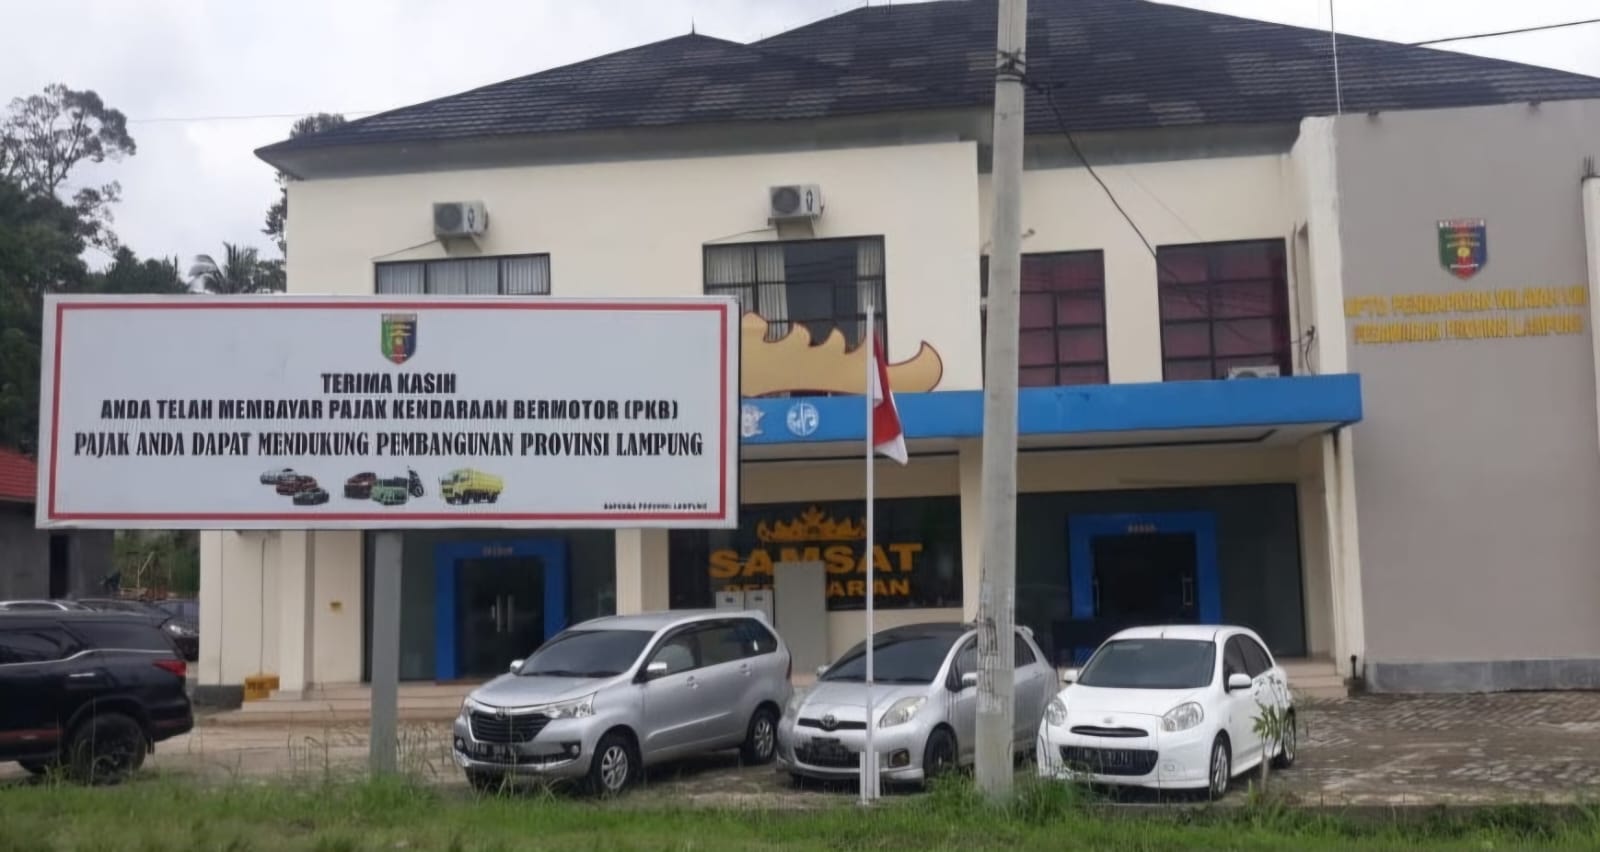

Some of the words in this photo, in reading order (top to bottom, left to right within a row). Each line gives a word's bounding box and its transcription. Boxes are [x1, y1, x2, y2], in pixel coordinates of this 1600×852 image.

[321, 373, 392, 394] TERIMA
[398, 373, 456, 394] KASIH
[101, 399, 151, 420] ANDA
[157, 399, 212, 420] TELAH
[219, 399, 323, 420] MEMBAYAR
[329, 399, 387, 420] PAJAK
[393, 399, 507, 420] KENDARAAN
[513, 400, 618, 420] BERMOTOR
[624, 400, 678, 420] (PKB)
[75, 432, 129, 458] PAJAK
[136, 432, 185, 456] ANDA
[192, 432, 251, 456] DAPAT
[258, 432, 369, 456] MENDUKUNG
[377, 432, 513, 456] PEMBANGUNAN
[521, 432, 609, 456] PROVINSI
[617, 432, 703, 456] LAMPUNG
[709, 543, 922, 578] SAMSAT
